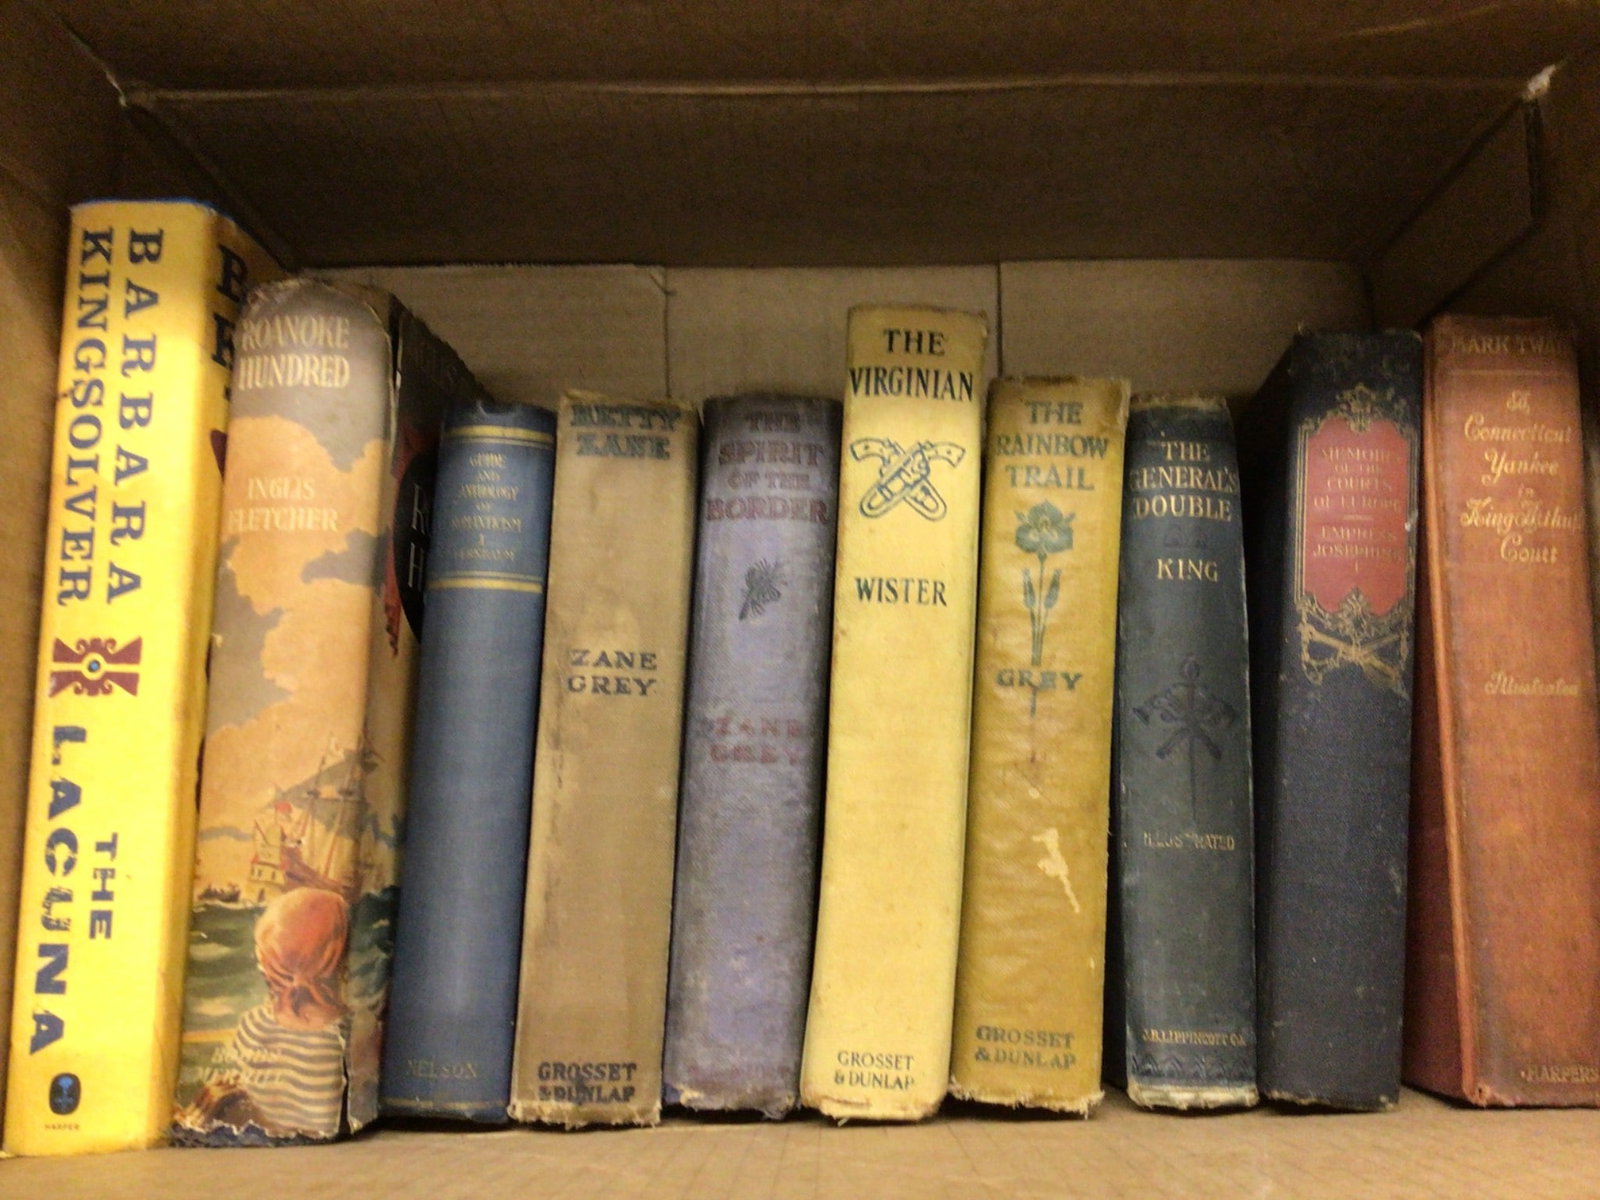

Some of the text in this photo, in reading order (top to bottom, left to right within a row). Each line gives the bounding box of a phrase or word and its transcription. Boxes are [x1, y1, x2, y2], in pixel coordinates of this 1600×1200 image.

[241, 315, 350, 350] ROANOKE
[883, 328, 945, 357] THE
[239, 353, 350, 391] HUNDRED
[849, 366, 974, 402] VIRGINIAN
[58, 227, 114, 607] KINGSOLVER
[107, 228, 164, 604] BARBARA
[1024, 401, 1084, 427] THE
[1464, 412, 1572, 444] Connecticut
[996, 432, 1109, 460] RAINBOW
[1160, 440, 1211, 464] THE
[1005, 464, 1095, 492] TRAIL
[1129, 465, 1238, 495] GENERAL'S
[1481, 448, 1560, 487] Yankee
[247, 476, 316, 500] INGLIS
[228, 507, 338, 532] FLETCHER
[706, 497, 829, 524] BORDER
[1133, 494, 1232, 523] DOUBLE
[1460, 497, 1515, 535] King
[1501, 533, 1558, 564] Court
[1156, 557, 1219, 583] KING
[855, 577, 948, 607] WISTER
[570, 649, 658, 671] ZANE
[567, 675, 657, 697] GREY
[995, 668, 1083, 691] GREY
[30, 725, 86, 1055] LACUNA
[89, 832, 118, 940] THE
[976, 1025, 1076, 1050] GROSSET
[537, 1061, 638, 1082] GROSSET
[837, 1050, 914, 1071] GROSSET
[995, 1050, 1077, 1072] DUNLAP
[849, 1072, 914, 1090] DUNLAP
